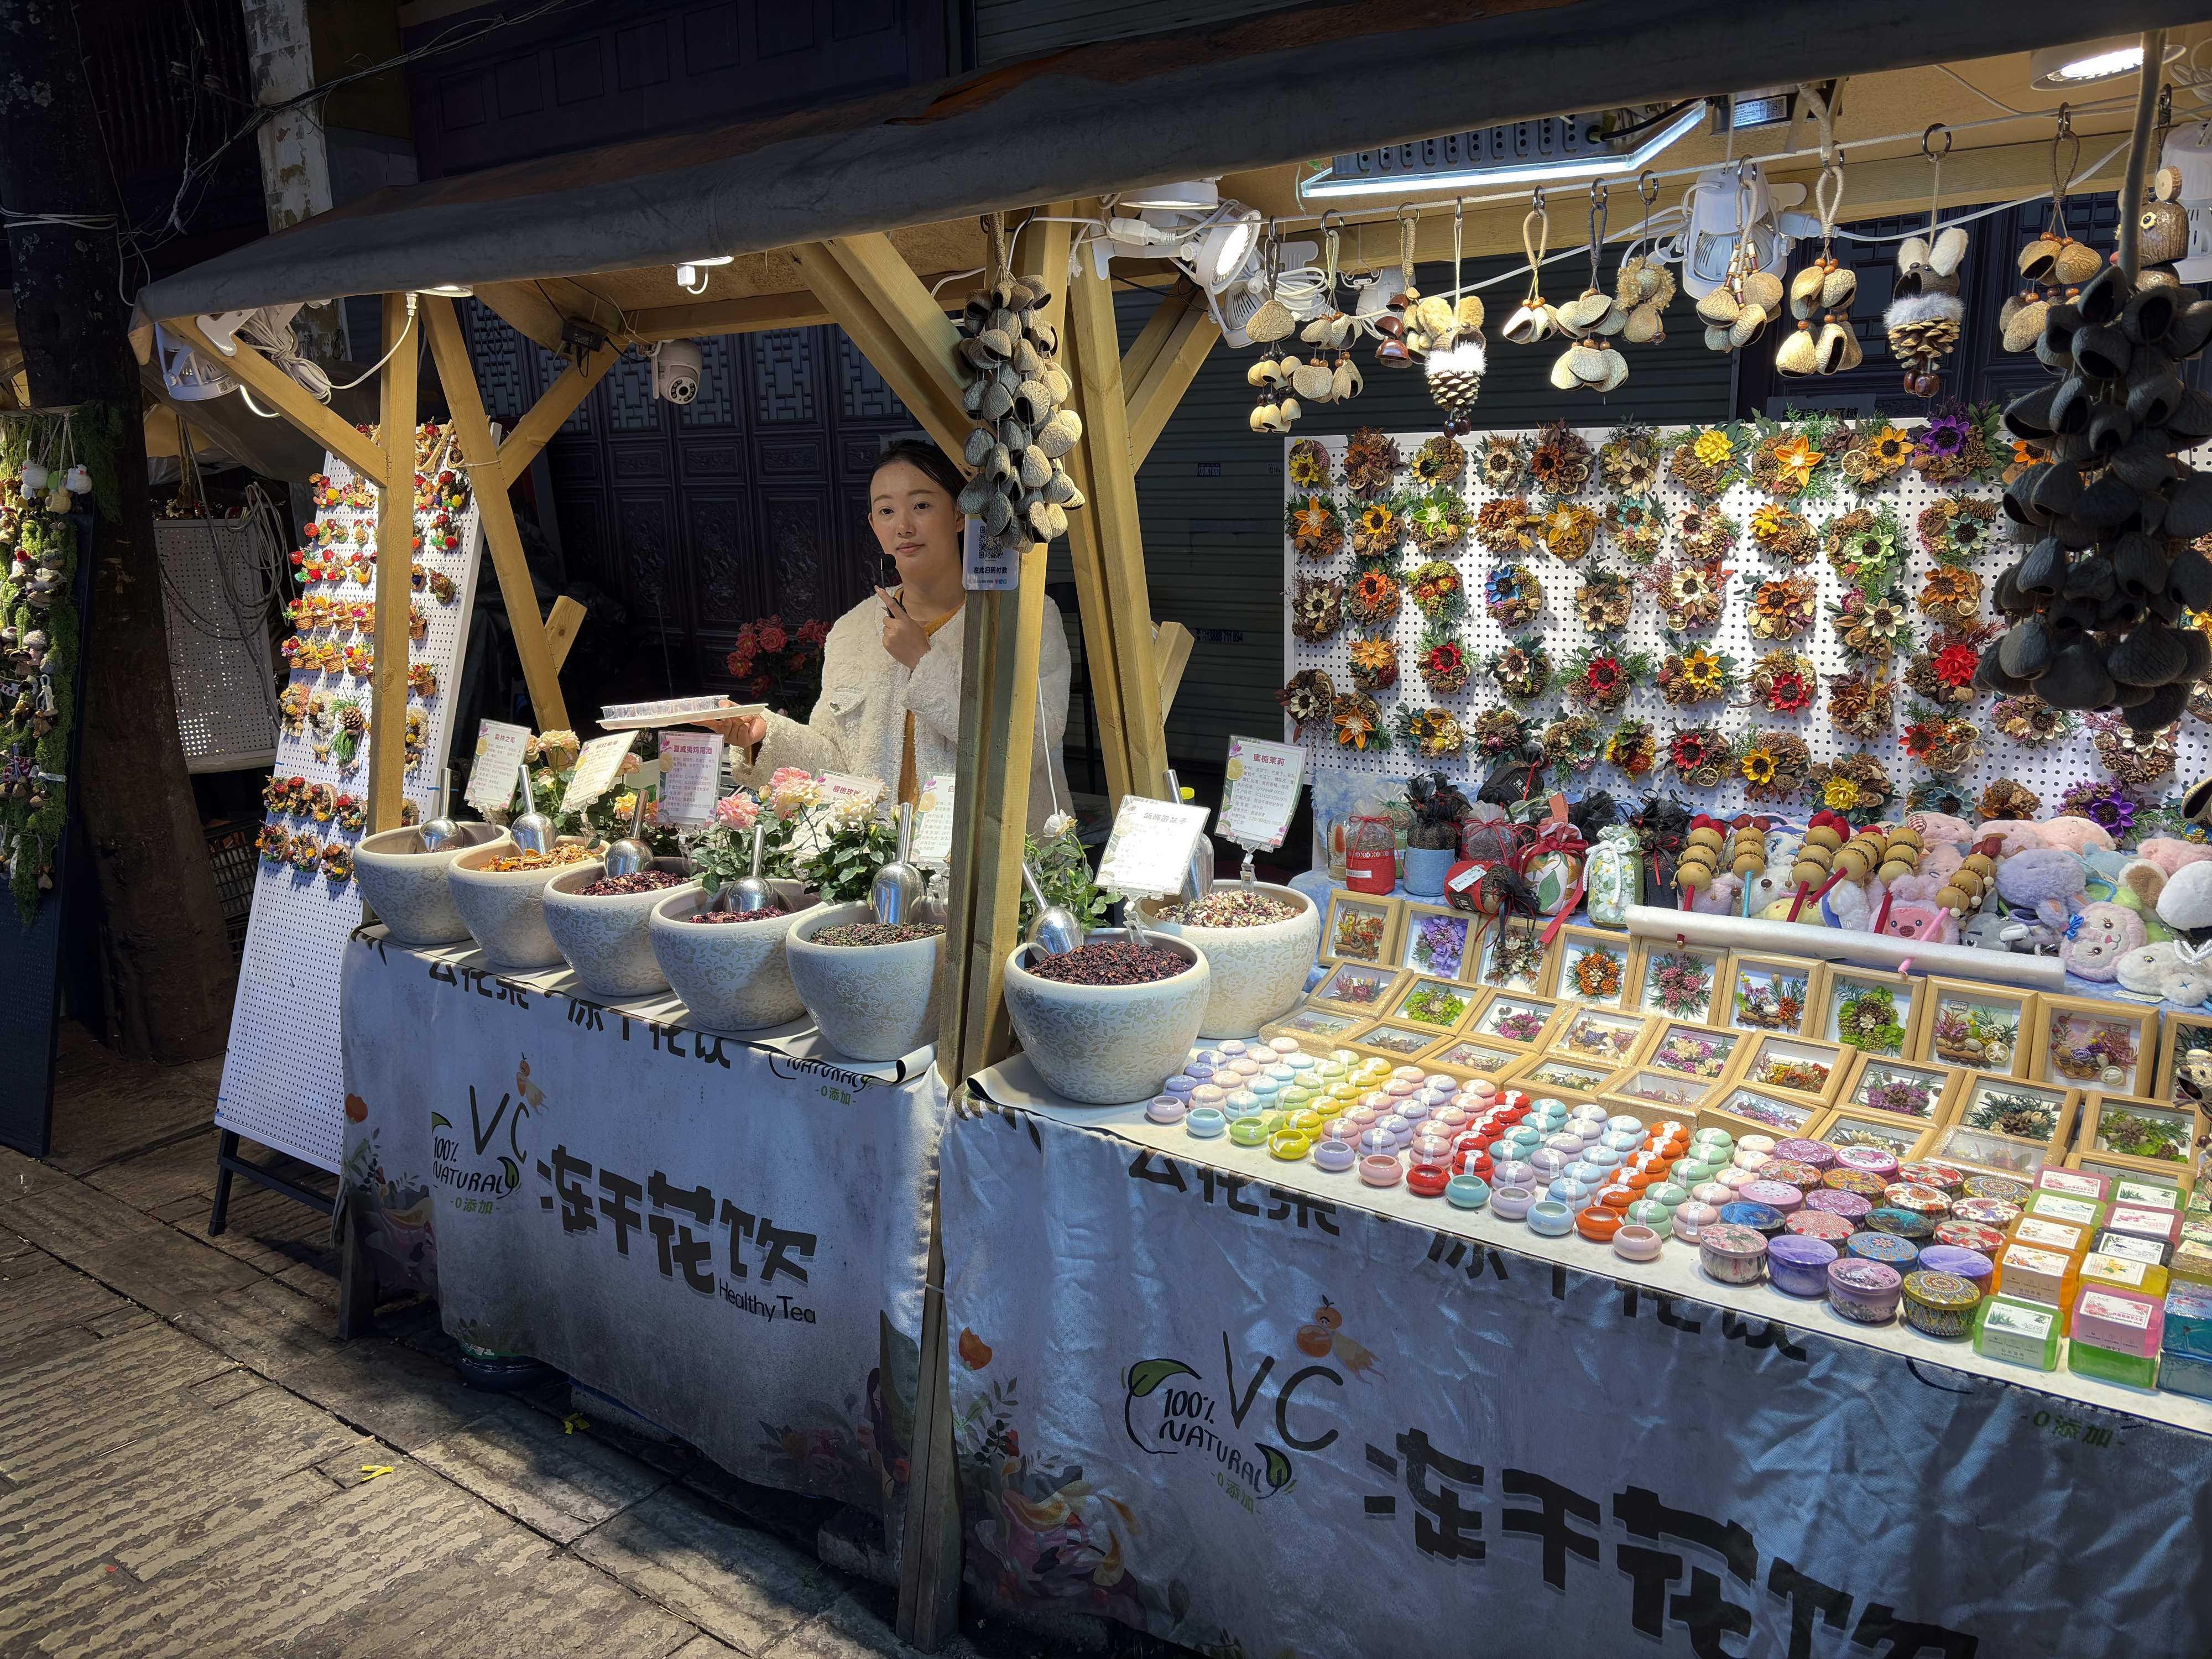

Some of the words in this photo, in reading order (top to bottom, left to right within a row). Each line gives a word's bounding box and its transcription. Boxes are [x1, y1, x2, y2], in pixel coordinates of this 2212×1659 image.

[674, 745, 712, 754] 夏威夷鸡尾酒
[1253, 754, 1285, 766] 蜜栀茉莉
[469, 1085, 529, 1164] VC
[433, 1136, 457, 1164] 100%
[537, 1144, 817, 1295] 冻干花饮
[719, 1282, 775, 1323] Healthy
[781, 1296, 817, 1325] Tea
[1164, 1388, 1215, 1425] 100%
[1223, 1331, 1344, 1452] VC
